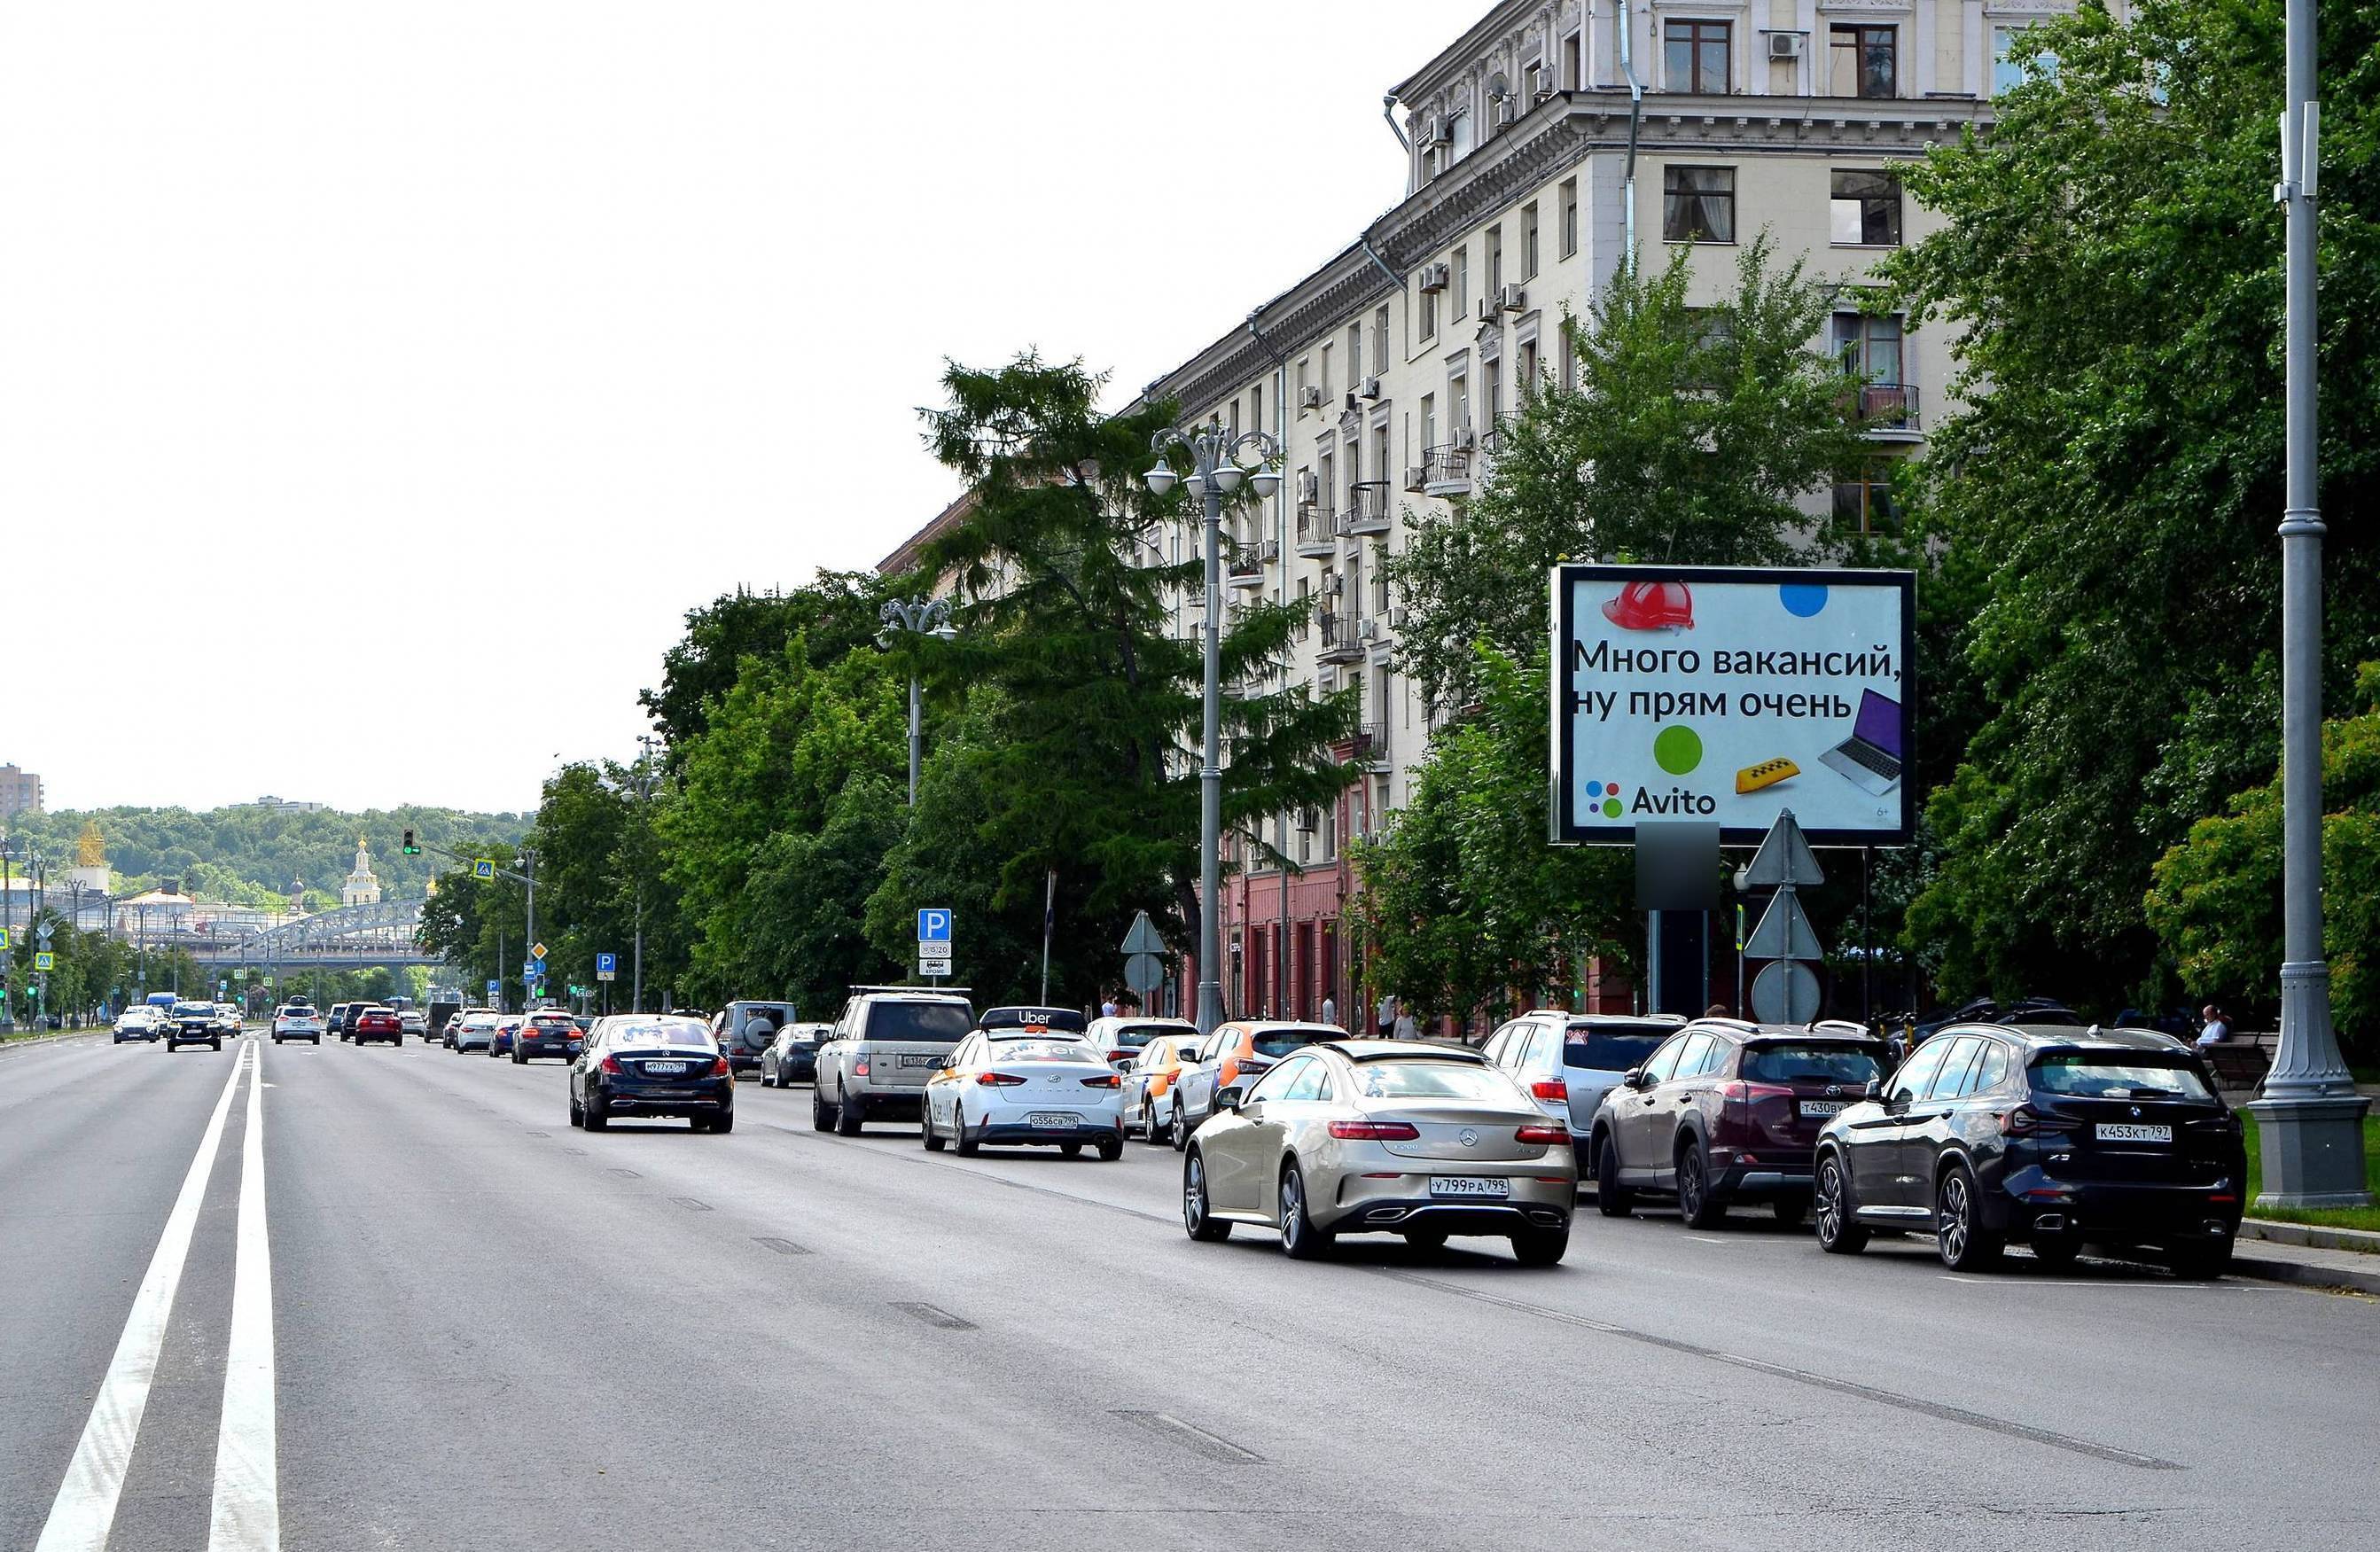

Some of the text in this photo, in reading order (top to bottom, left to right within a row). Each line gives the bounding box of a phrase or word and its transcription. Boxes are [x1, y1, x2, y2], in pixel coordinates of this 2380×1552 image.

[1574, 640, 1901, 681] Много вакансий,
[1573, 690, 1851, 721] ну прям очень
[1631, 786, 1716, 815] Avito
[1877, 806, 1888, 816] 6+
[927, 913, 945, 938] P
[601, 955, 611, 969] P
[1018, 1010, 1051, 1024] Uber
[1804, 1103, 1843, 1113] Т430ВУ
[2100, 1126, 2168, 1139] К453КТ 797
[1434, 1179, 1504, 1192] У799РА 799
